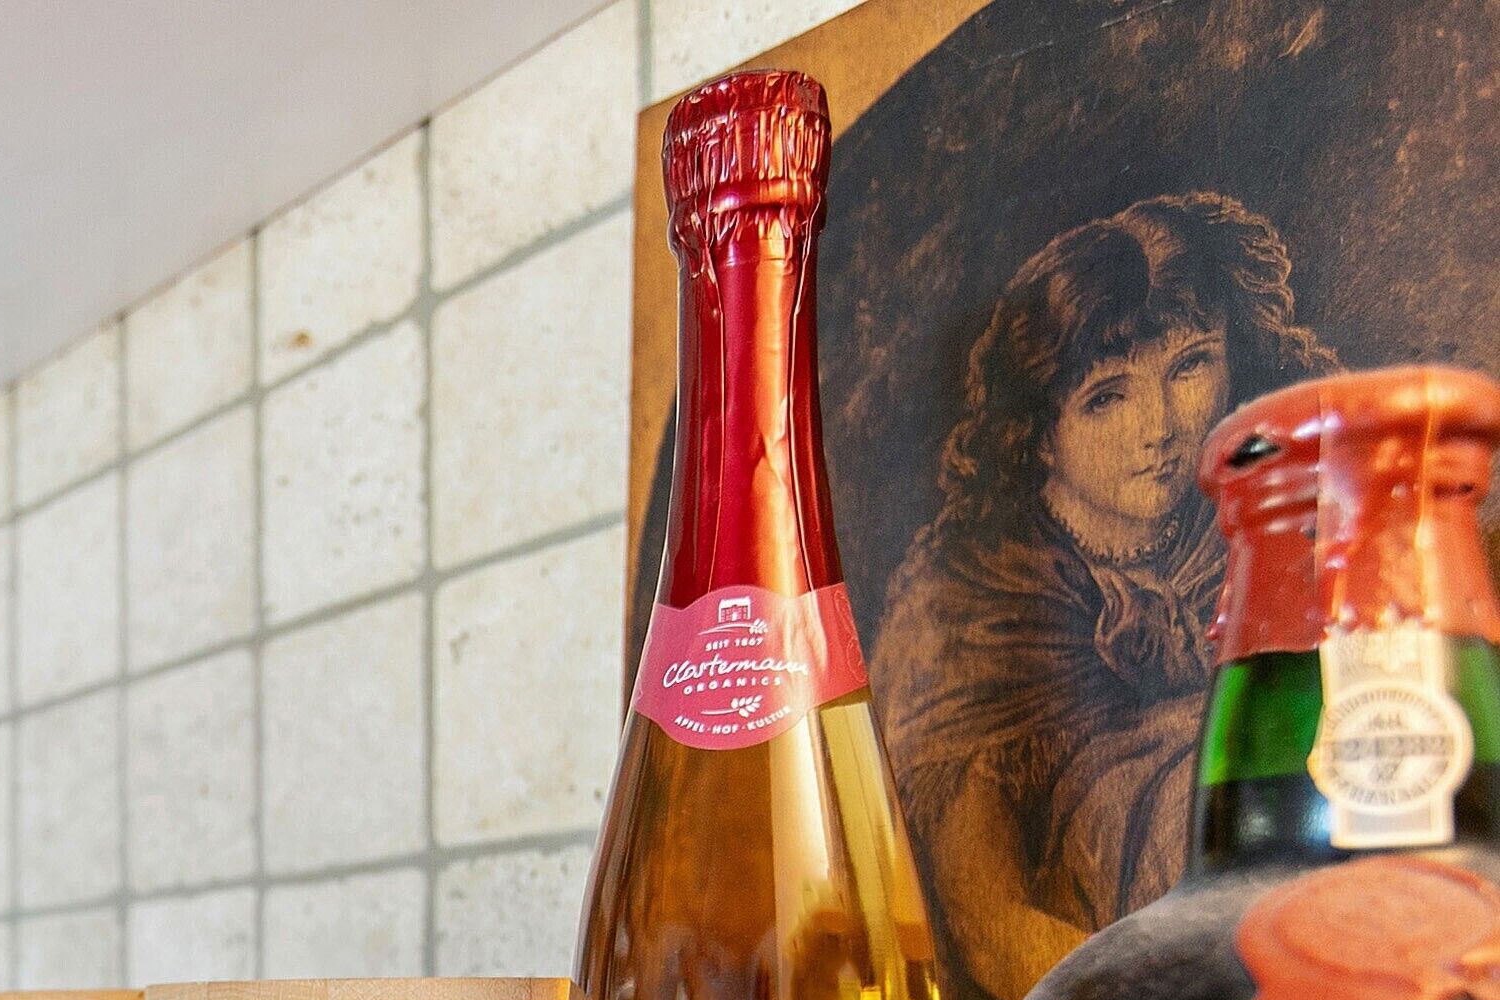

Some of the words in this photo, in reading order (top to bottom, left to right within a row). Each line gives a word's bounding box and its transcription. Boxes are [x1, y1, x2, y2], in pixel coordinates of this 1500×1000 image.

[705, 639, 730, 651] SEIT
[735, 637, 764, 647] 1867
[663, 653, 808, 688] Clostermann
[683, 676, 782, 695] ORGANICS
[712, 724, 739, 734] HOF
